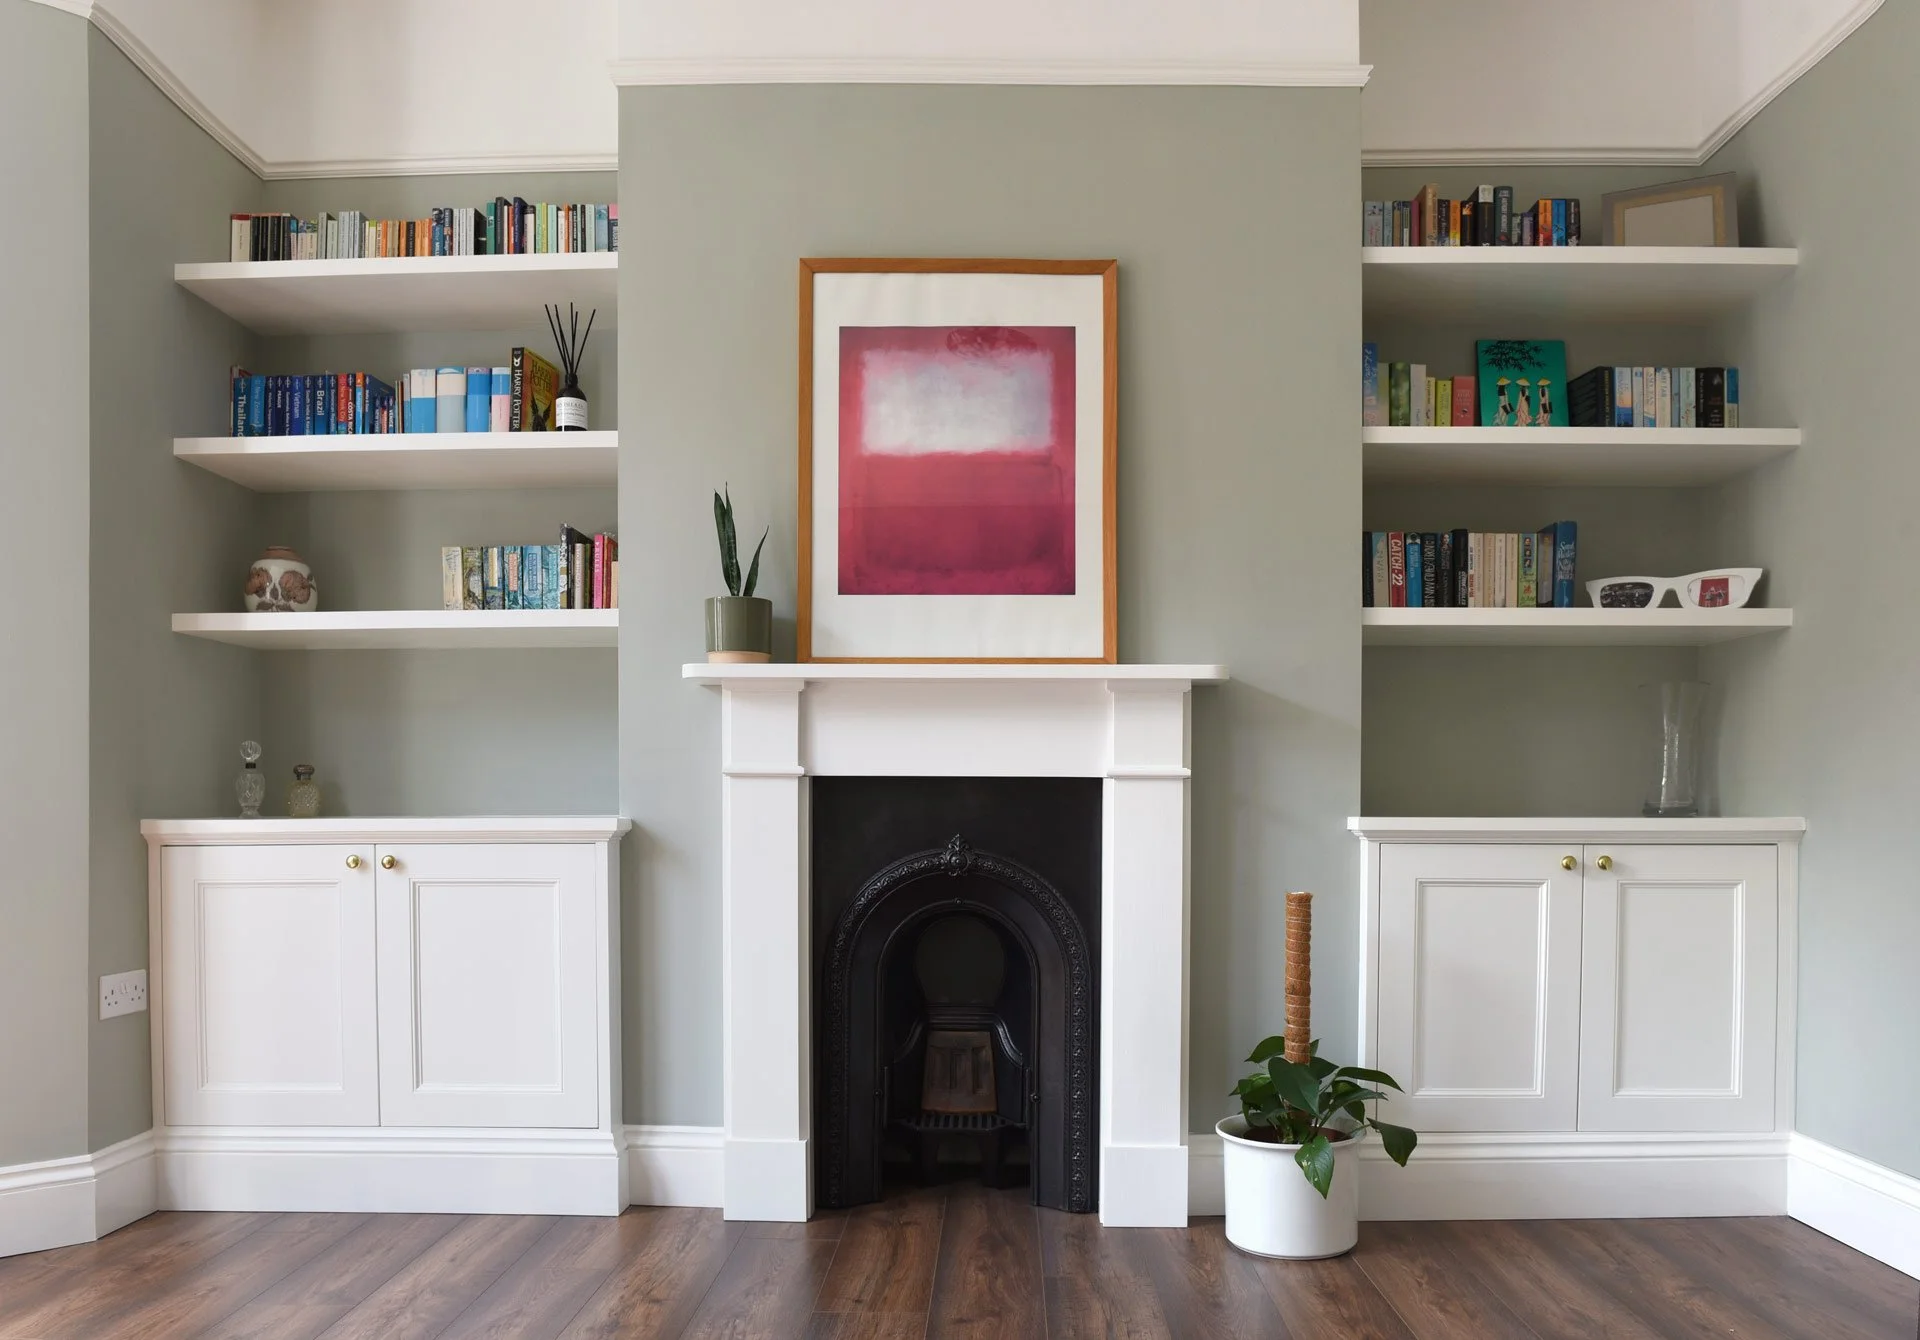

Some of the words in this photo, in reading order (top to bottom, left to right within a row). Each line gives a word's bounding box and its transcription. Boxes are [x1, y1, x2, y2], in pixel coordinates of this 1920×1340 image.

[514, 369, 522, 397] HARRY
[316, 390, 325, 416] Brazil
[513, 399, 521, 429] POTTER
[1391, 539, 1403, 586] CATCH-22
